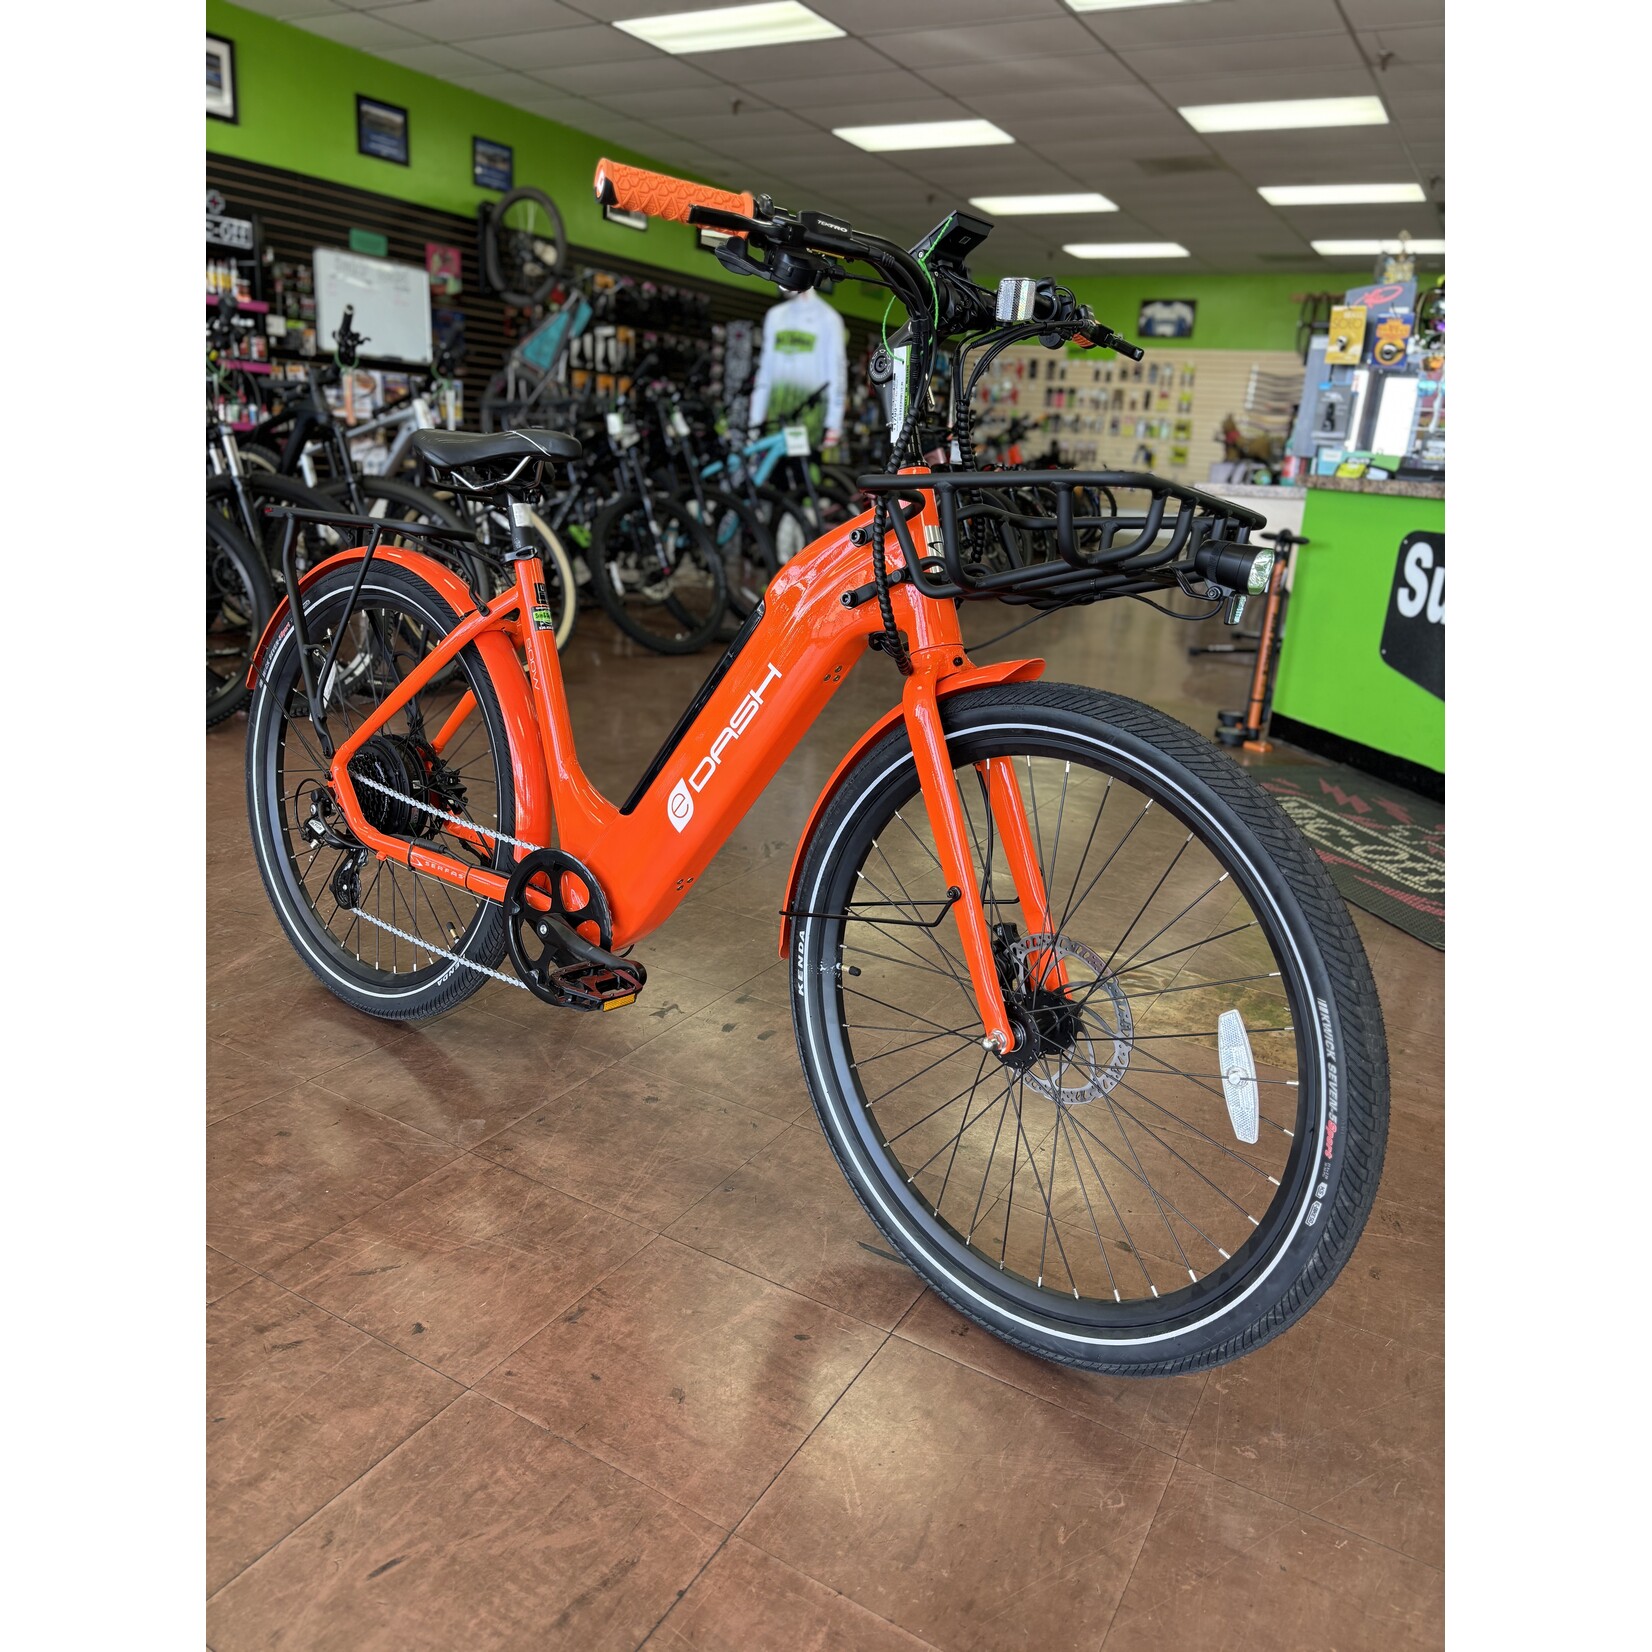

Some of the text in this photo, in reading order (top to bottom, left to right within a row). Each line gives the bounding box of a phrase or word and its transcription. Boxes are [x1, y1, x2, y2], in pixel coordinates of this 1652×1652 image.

[817, 219, 848, 233] TEKTRO
[688, 662, 783, 794] DASH
[437, 961, 460, 987] ENDA
[797, 930, 805, 997] KENDA
[1321, 1014, 1336, 1062] KWICK
